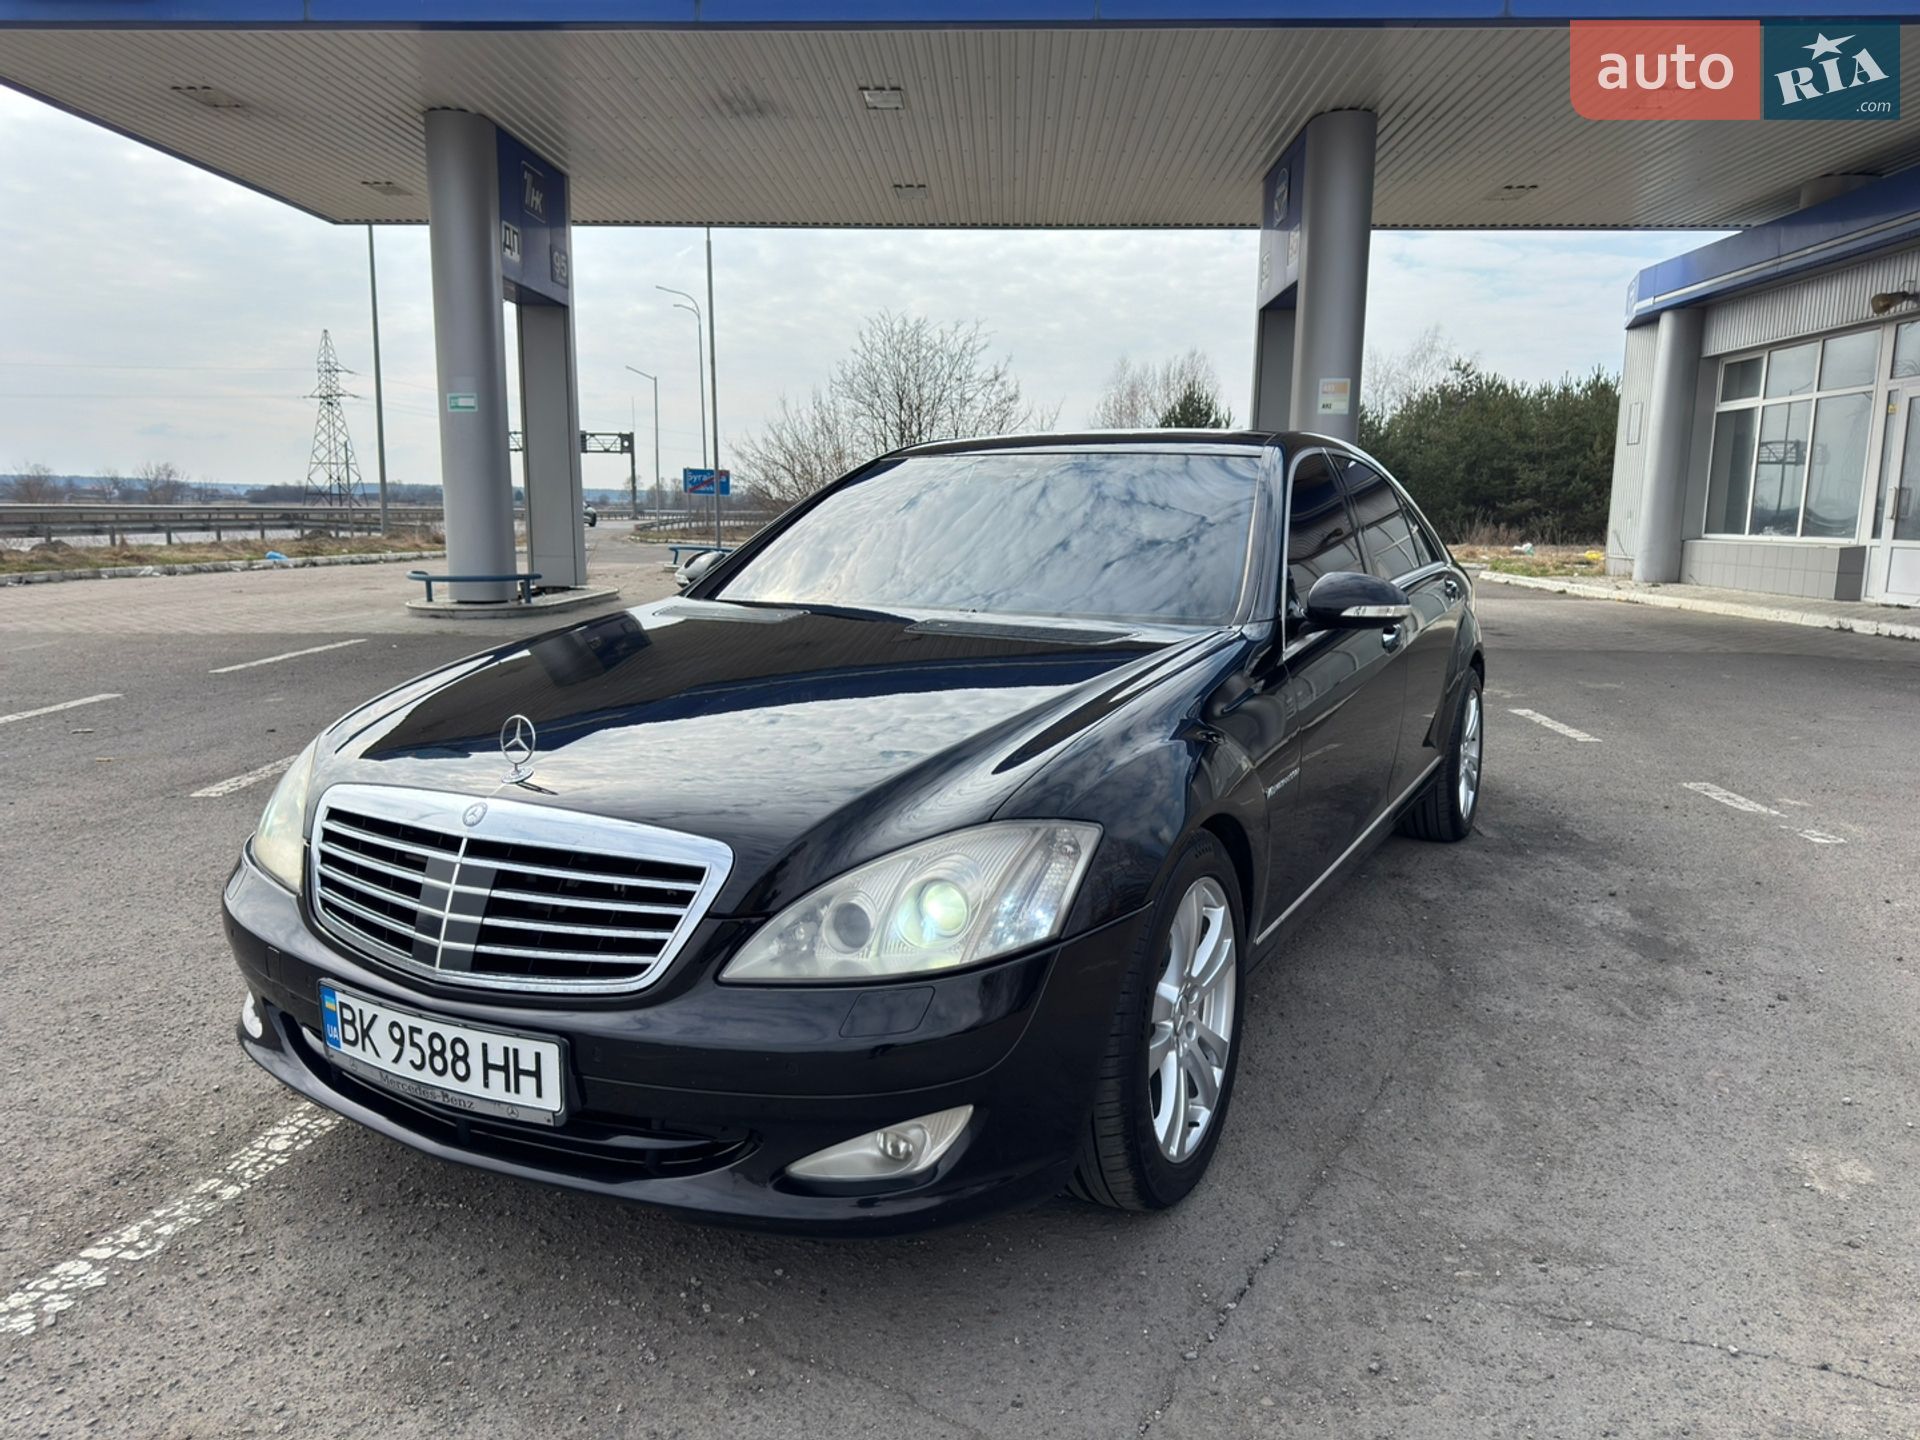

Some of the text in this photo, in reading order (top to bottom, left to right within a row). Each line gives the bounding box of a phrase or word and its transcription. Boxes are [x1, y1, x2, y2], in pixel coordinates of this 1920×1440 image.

[552, 250, 568, 278] 95
[327, 1023, 340, 1042] UA
[338, 1000, 543, 1099] BK 9588 HH
[378, 1070, 477, 1111] Mercedes-Benz
